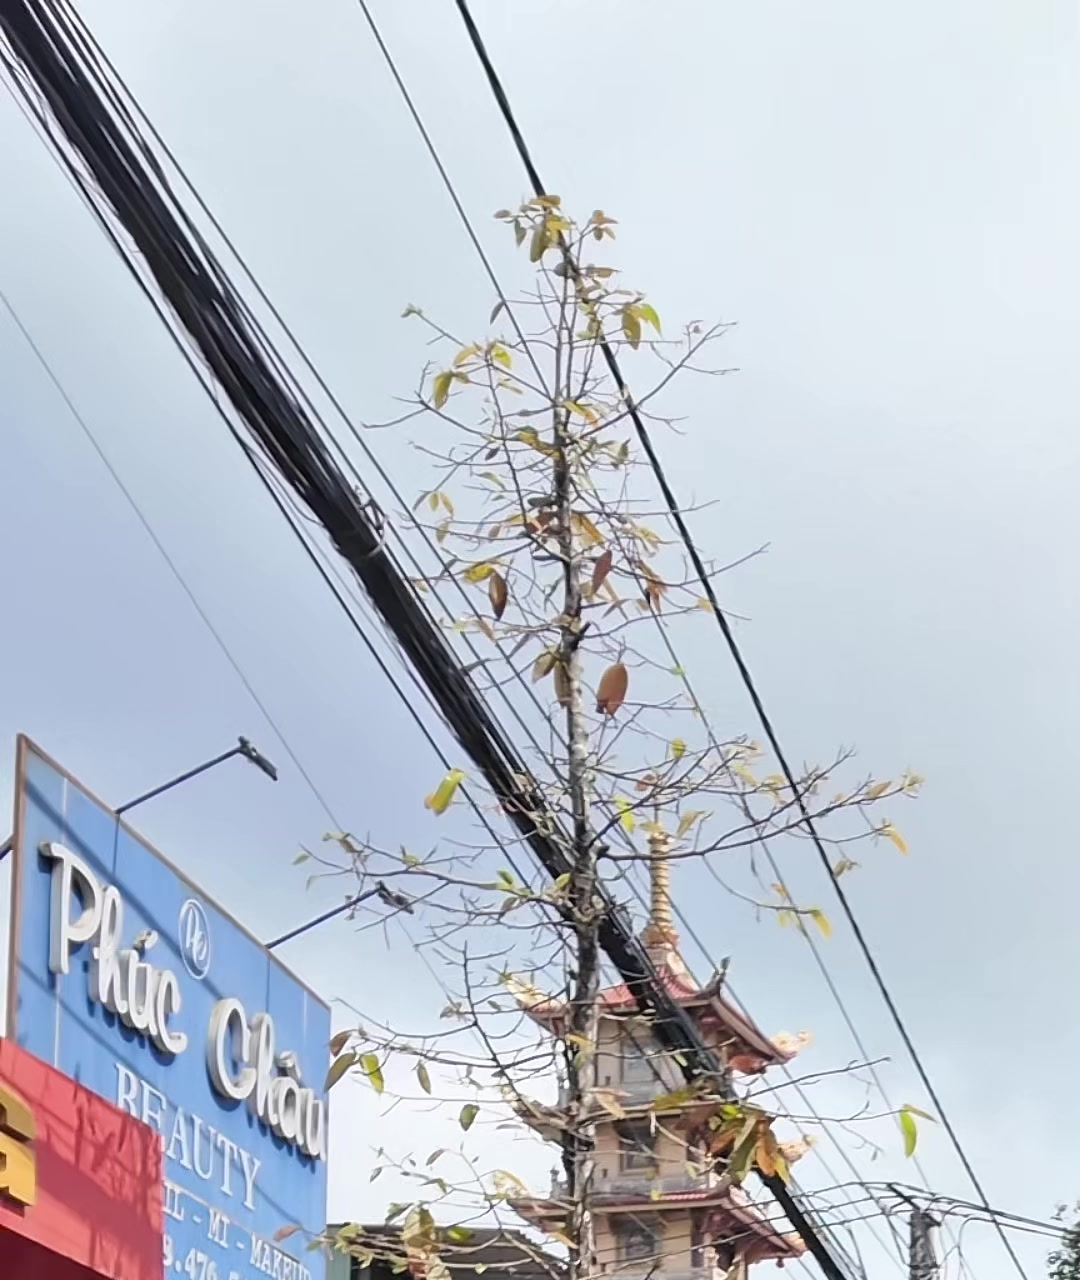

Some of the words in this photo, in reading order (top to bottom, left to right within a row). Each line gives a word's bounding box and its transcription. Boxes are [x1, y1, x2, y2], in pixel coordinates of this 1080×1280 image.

[38, 841, 188, 1055] Phúc
[207, 998, 327, 1162] Châu
[115, 1063, 261, 1212] BEAUTY
[206, 1206, 231, 1249] MI
